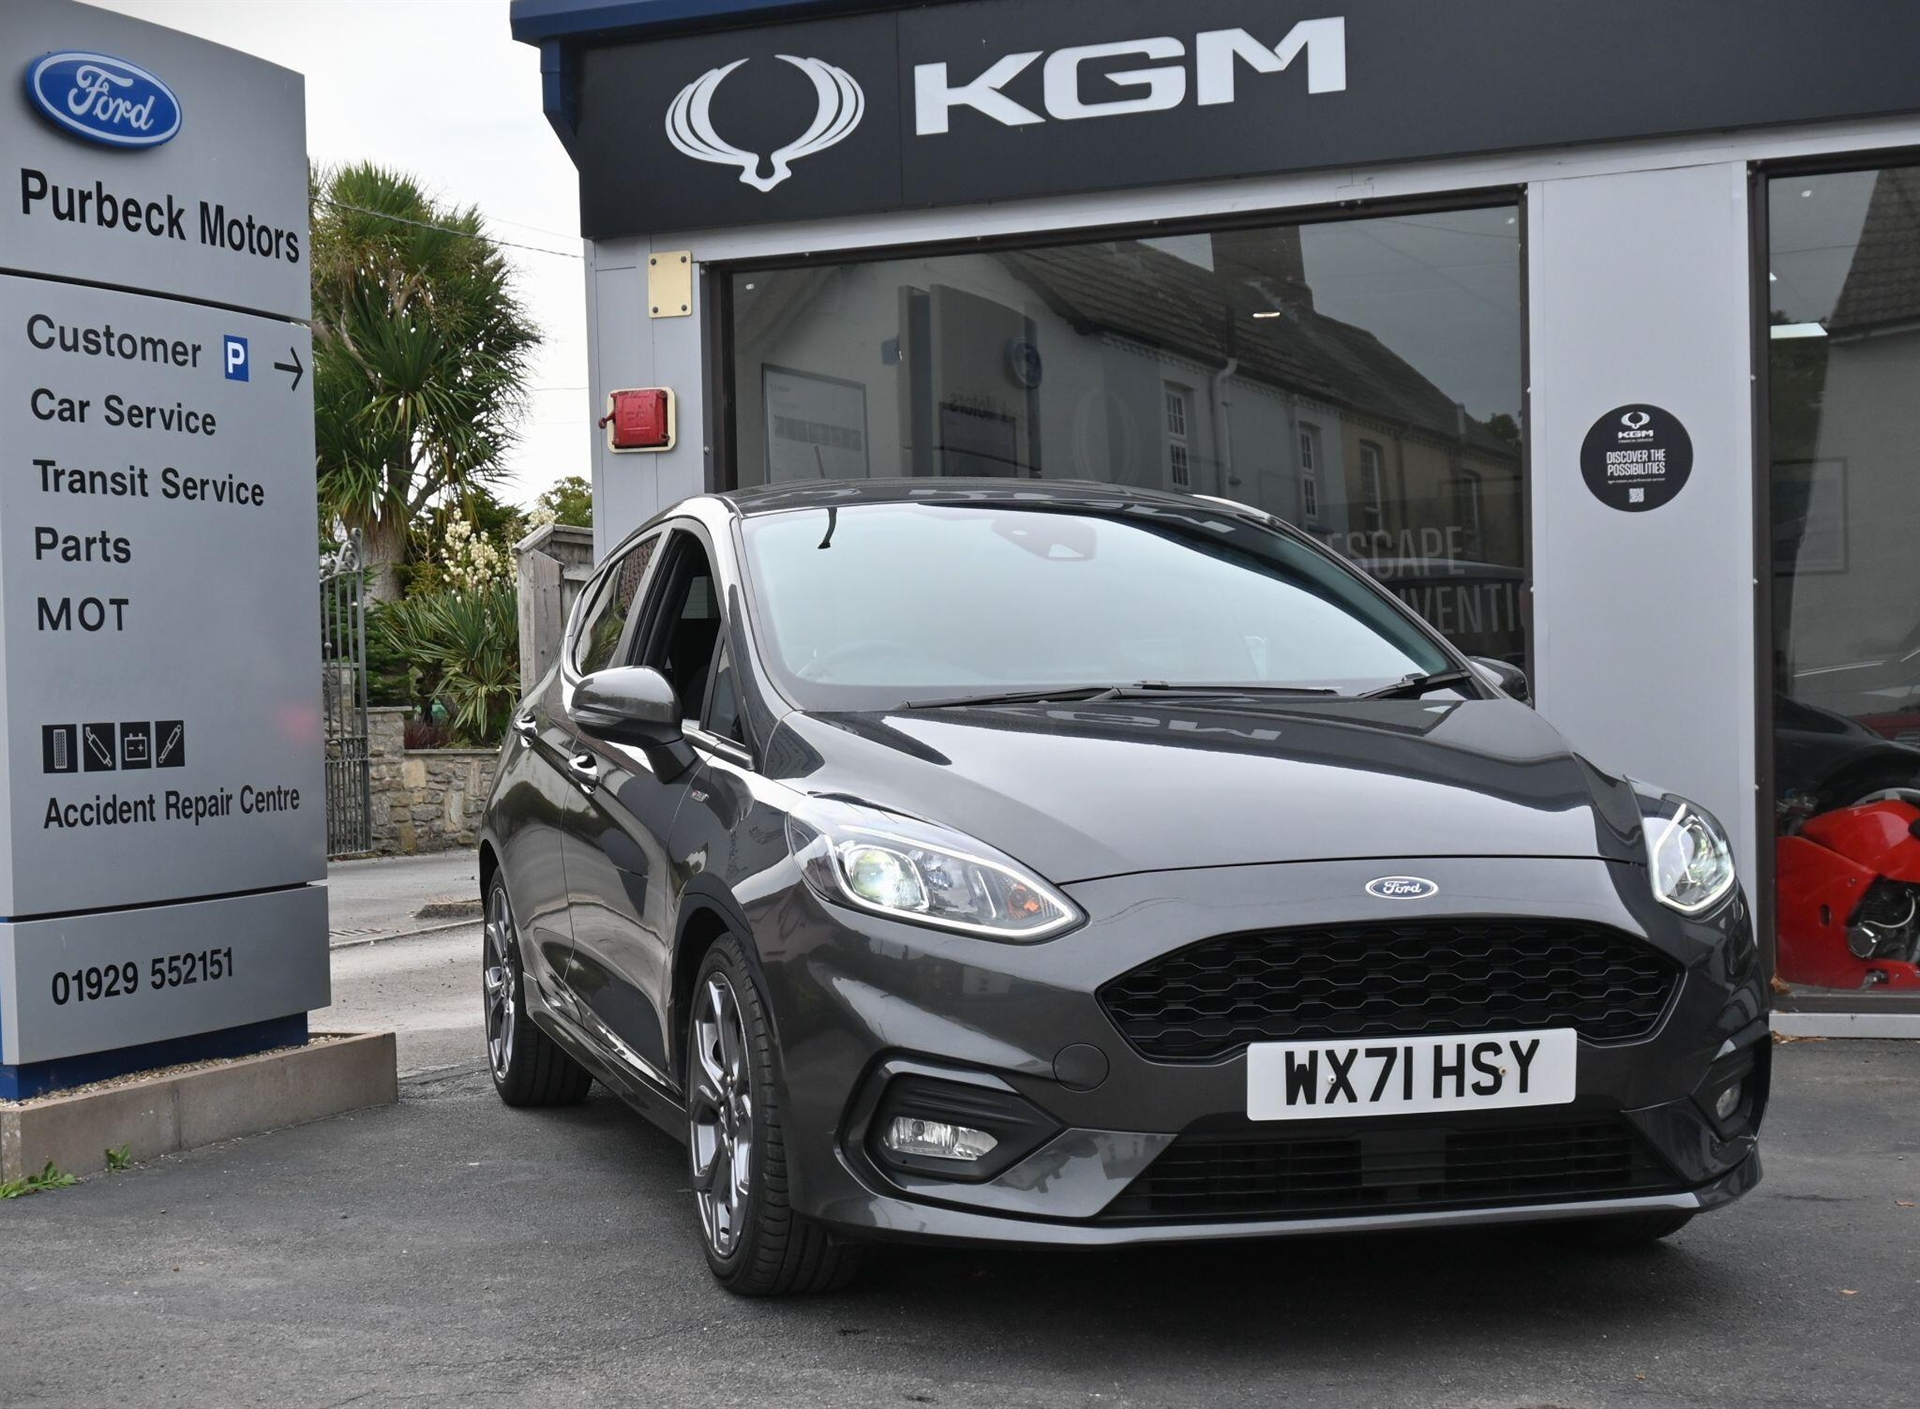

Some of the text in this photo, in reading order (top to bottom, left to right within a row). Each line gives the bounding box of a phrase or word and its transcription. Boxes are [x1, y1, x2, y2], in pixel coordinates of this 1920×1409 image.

[67, 65, 154, 131] Ford
[914, 16, 1346, 136] KGM
[20, 168, 300, 263] Purbeck Motors
[27, 314, 246, 374] Customer P
[30, 388, 217, 436] Car Service
[1618, 429, 1654, 438] KGM
[1606, 448, 1666, 463] DISCOVER THE
[1607, 462, 1666, 476] POSSIBILITIES
[33, 459, 265, 507] Transit Service
[35, 526, 132, 564] Parts
[38, 597, 129, 632] MOT
[44, 784, 300, 829] Accident Repair Centre
[1383, 880, 1422, 894] Ford
[52, 947, 234, 1006] 01929 552151
[1285, 1038, 1541, 1106] WX71 HSY
